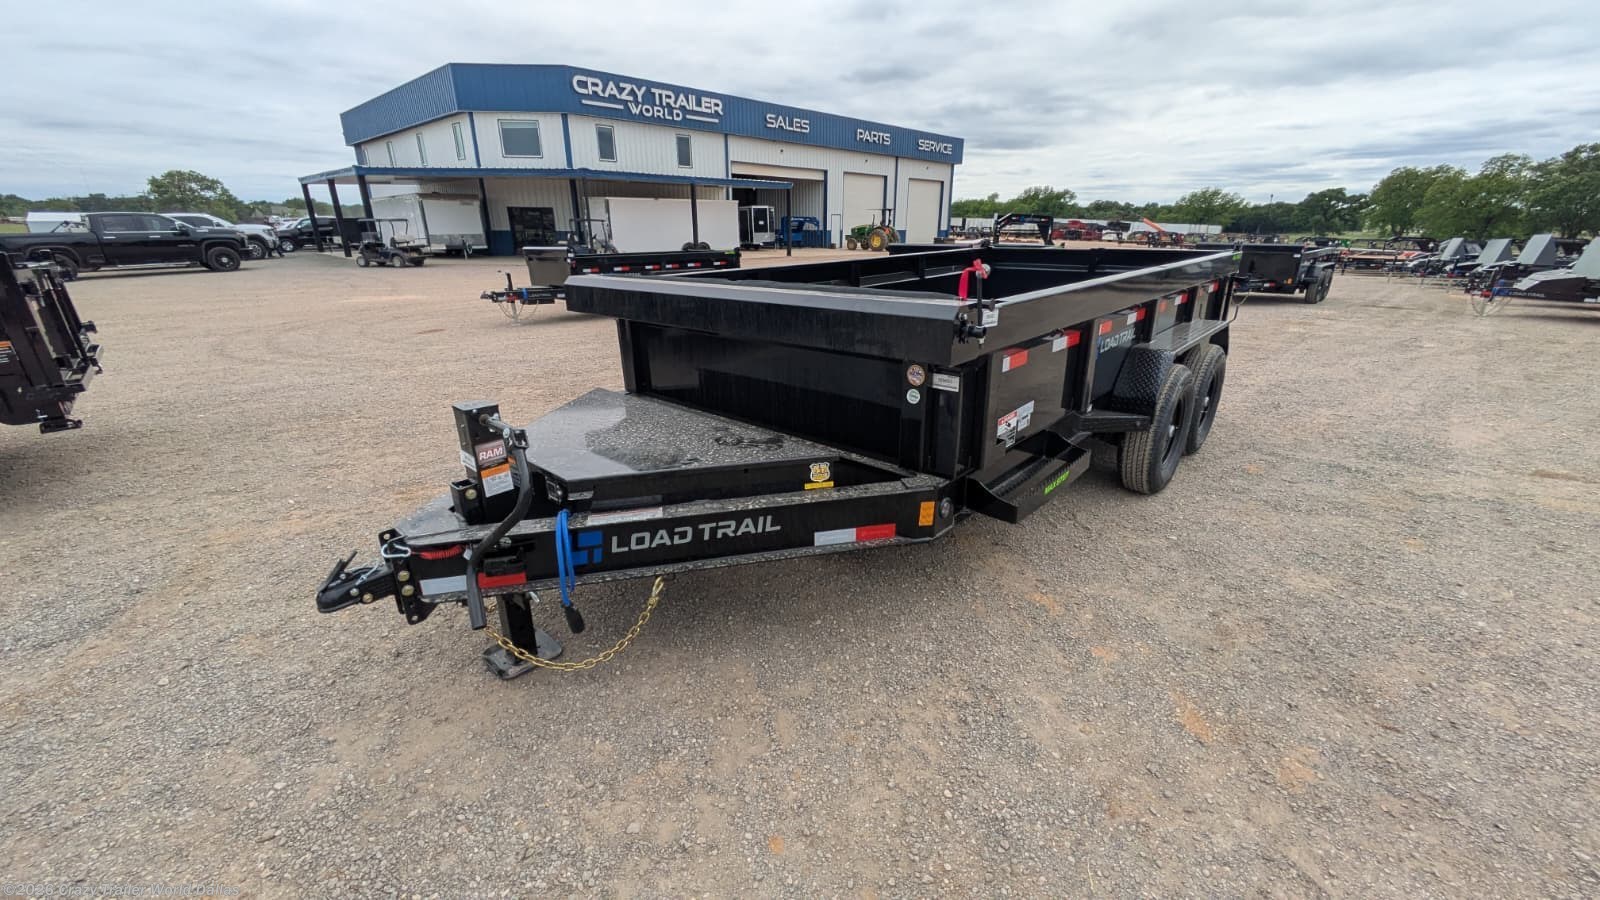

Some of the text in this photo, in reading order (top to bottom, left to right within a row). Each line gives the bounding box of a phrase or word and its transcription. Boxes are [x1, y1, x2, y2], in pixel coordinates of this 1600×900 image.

[572, 75, 724, 115] CRAZY TRAILER
[628, 102, 683, 121] WORLD
[766, 113, 810, 133] SALES
[857, 128, 891, 145] PARTS
[918, 139, 953, 154] SERVICE
[479, 447, 503, 460] RAM
[611, 515, 781, 553] LOAD TRAIL
